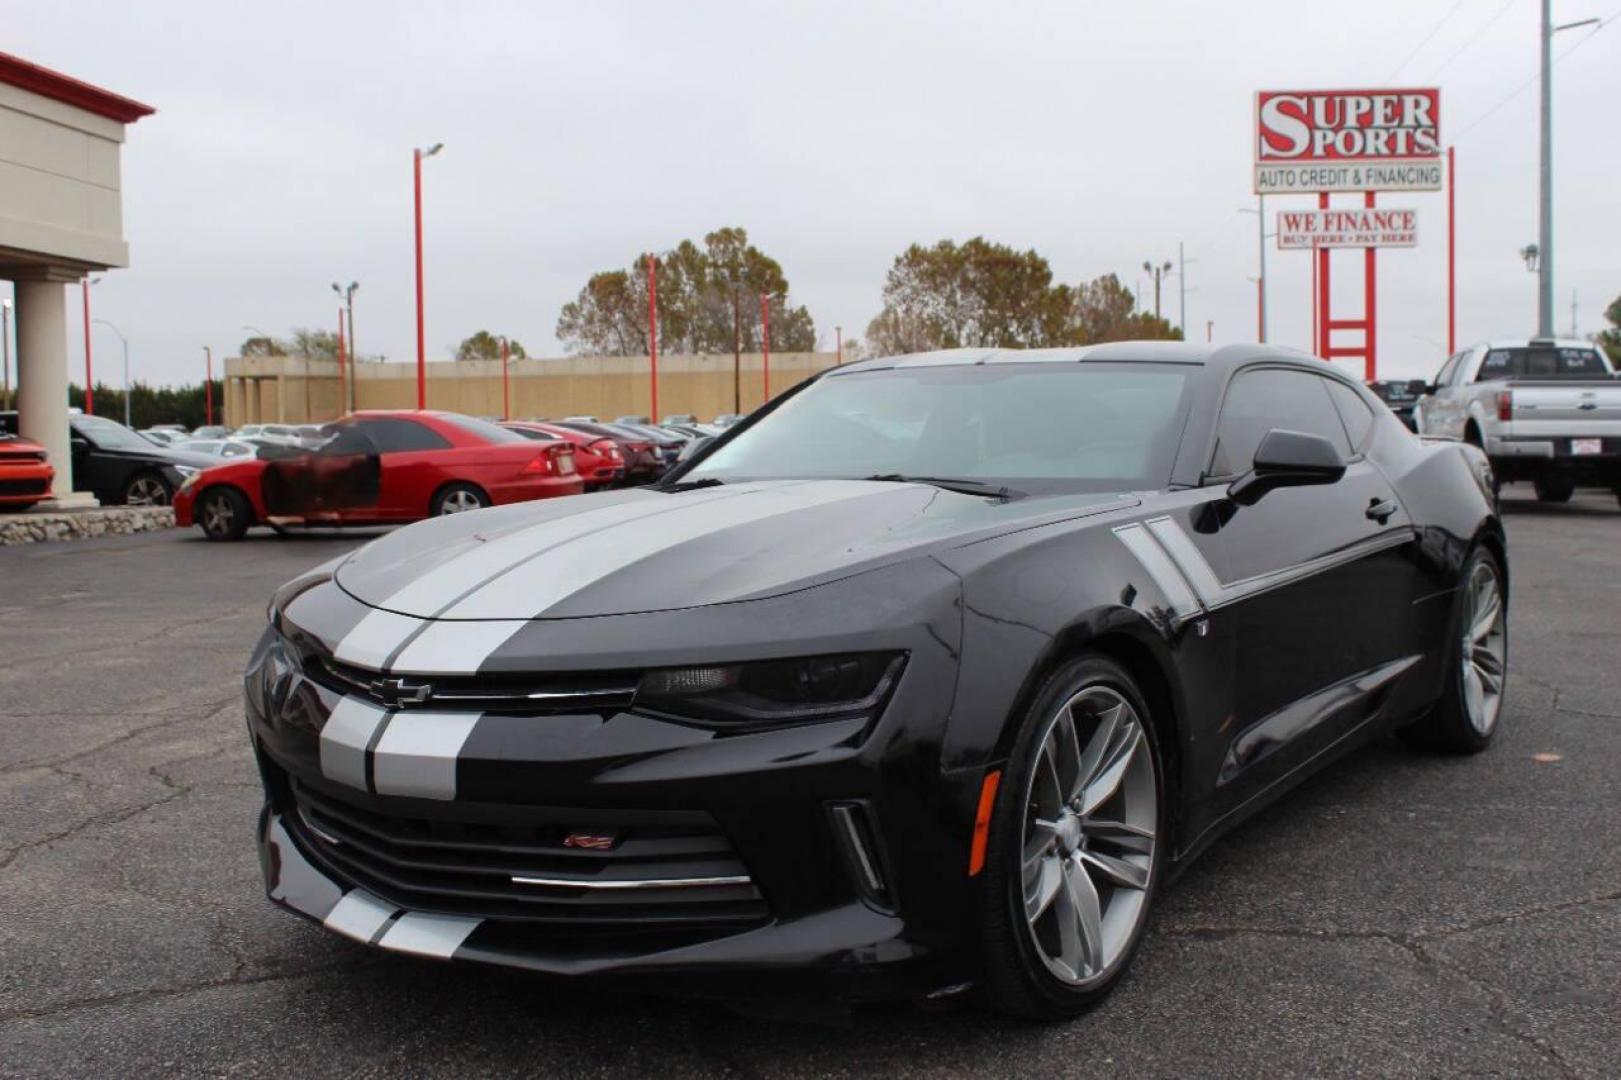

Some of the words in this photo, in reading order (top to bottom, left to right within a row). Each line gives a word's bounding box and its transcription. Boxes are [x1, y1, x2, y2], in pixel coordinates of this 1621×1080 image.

[1259, 169, 1296, 187] AUTO
[1300, 168, 1349, 186] CREDIT
[1353, 168, 1362, 184] &
[1366, 166, 1441, 184] FINANCING
[1283, 212, 1318, 232] WE
[1324, 210, 1416, 232] FINANCE
[1283, 235, 1307, 245] BUY
[1311, 234, 1345, 244] HERE
[1355, 234, 1377, 244] PAY
[1381, 233, 1415, 243] HERE
